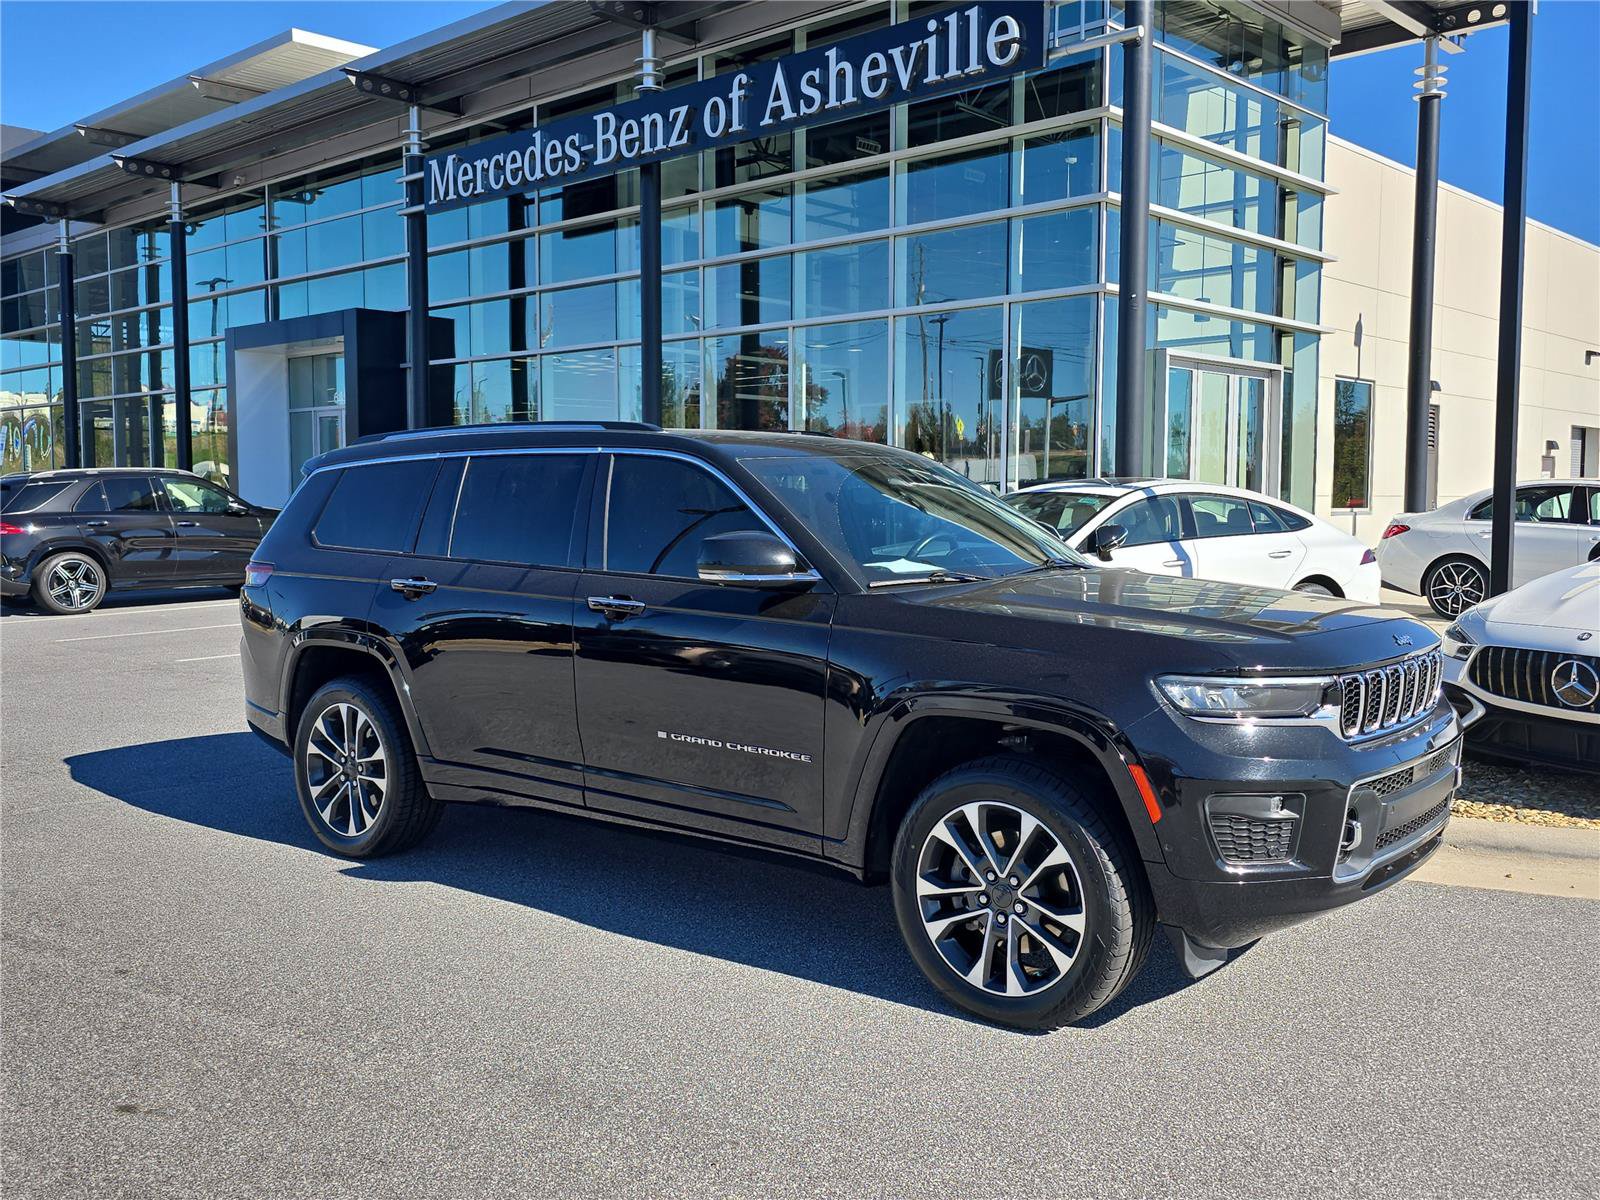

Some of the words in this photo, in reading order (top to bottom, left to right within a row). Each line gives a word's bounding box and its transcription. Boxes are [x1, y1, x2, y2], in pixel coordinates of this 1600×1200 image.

[428, 104, 690, 205] Mercedes-Benz
[703, 72, 749, 138] of
[759, 4, 1021, 127] Asheville
[670, 733, 723, 748] GRAND
[726, 742, 812, 763] CHEROKEE
